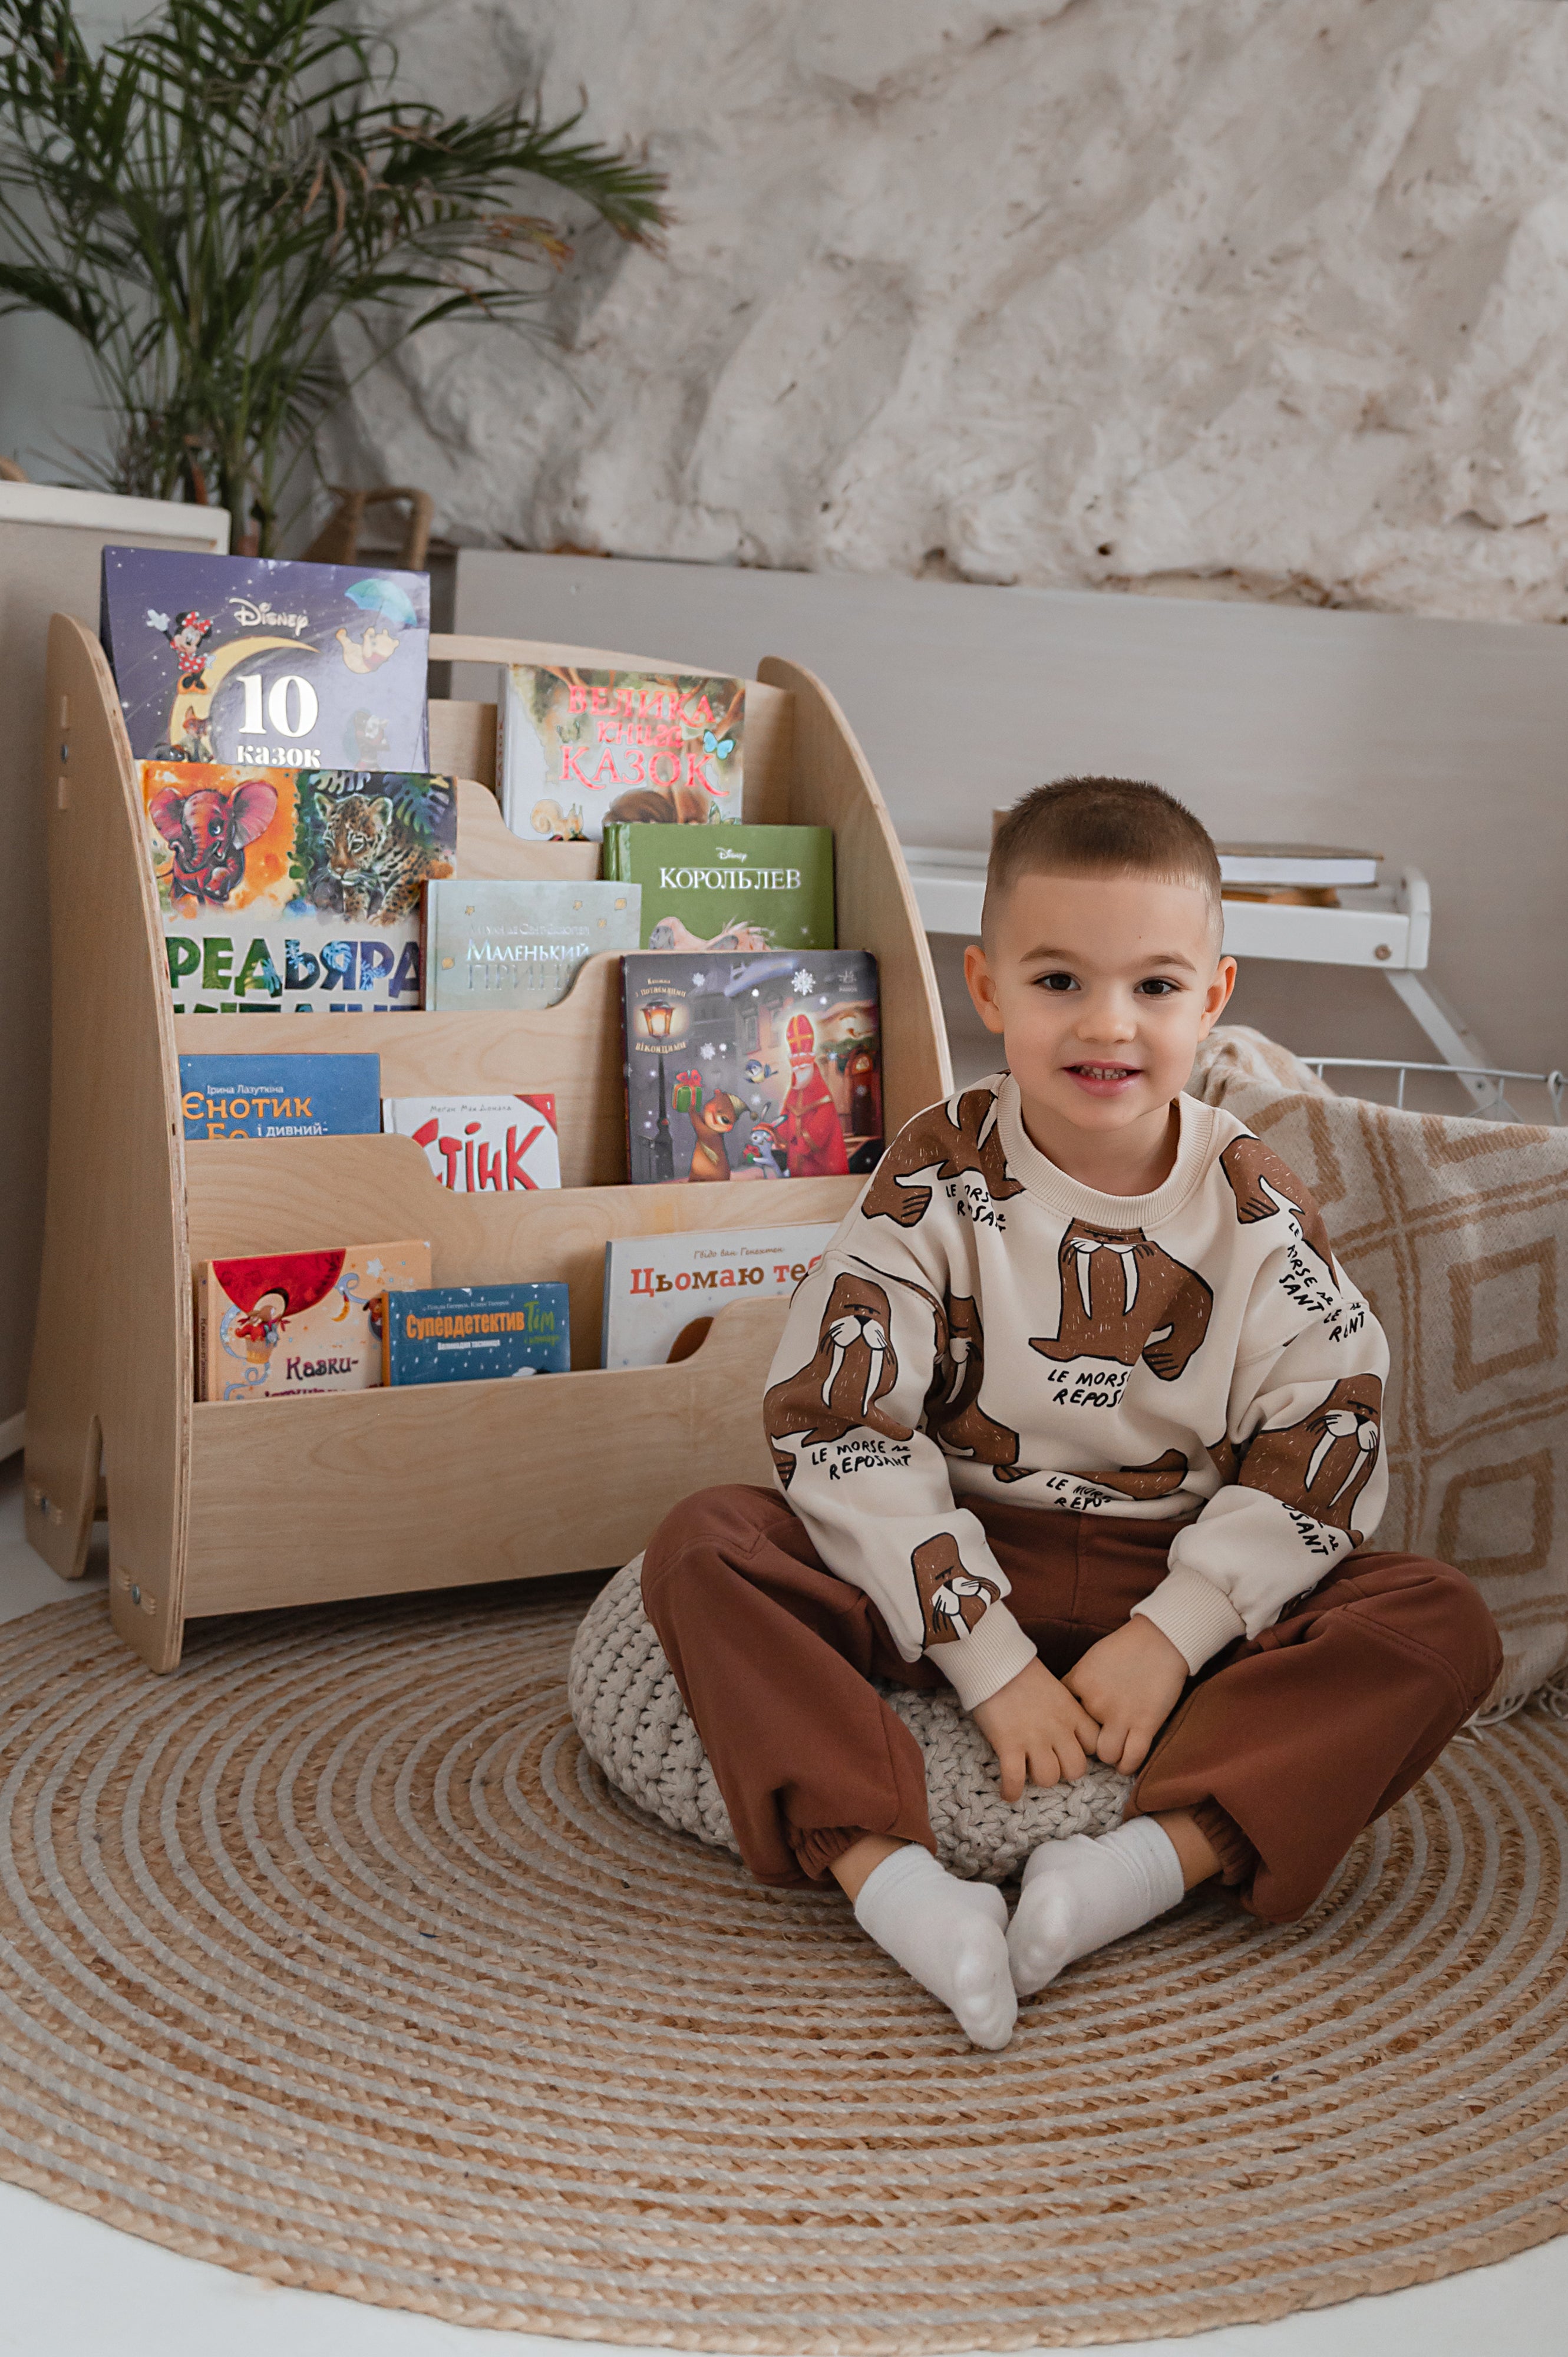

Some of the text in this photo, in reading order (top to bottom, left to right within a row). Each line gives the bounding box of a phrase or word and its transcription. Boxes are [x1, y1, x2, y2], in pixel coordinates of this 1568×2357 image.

[229, 597, 309, 636] Disney
[236, 674, 319, 737] 10
[567, 685, 717, 728] ВЕЛИКА
[237, 745, 321, 768] казок
[559, 745, 729, 797] КАЗОК
[715, 847, 747, 863] Disney
[659, 867, 801, 890] КОРОЛЬ ЛЕВ
[467, 963, 573, 991] ПРИН
[181, 1091, 313, 1120] Єнотик
[946, 1184, 956, 1197] LE
[629, 1266, 764, 1297] Цьомаю
[406, 1312, 525, 1341] Супердетектив
[1047, 1369, 1131, 1387] LE MORS
[1052, 1388, 1125, 1408] REPOS
[811, 1447, 827, 1465] LE
[837, 1440, 886, 1455] MORSE
[829, 1454, 912, 1480] REPOSANT
[1046, 1476, 1069, 1491] LE
